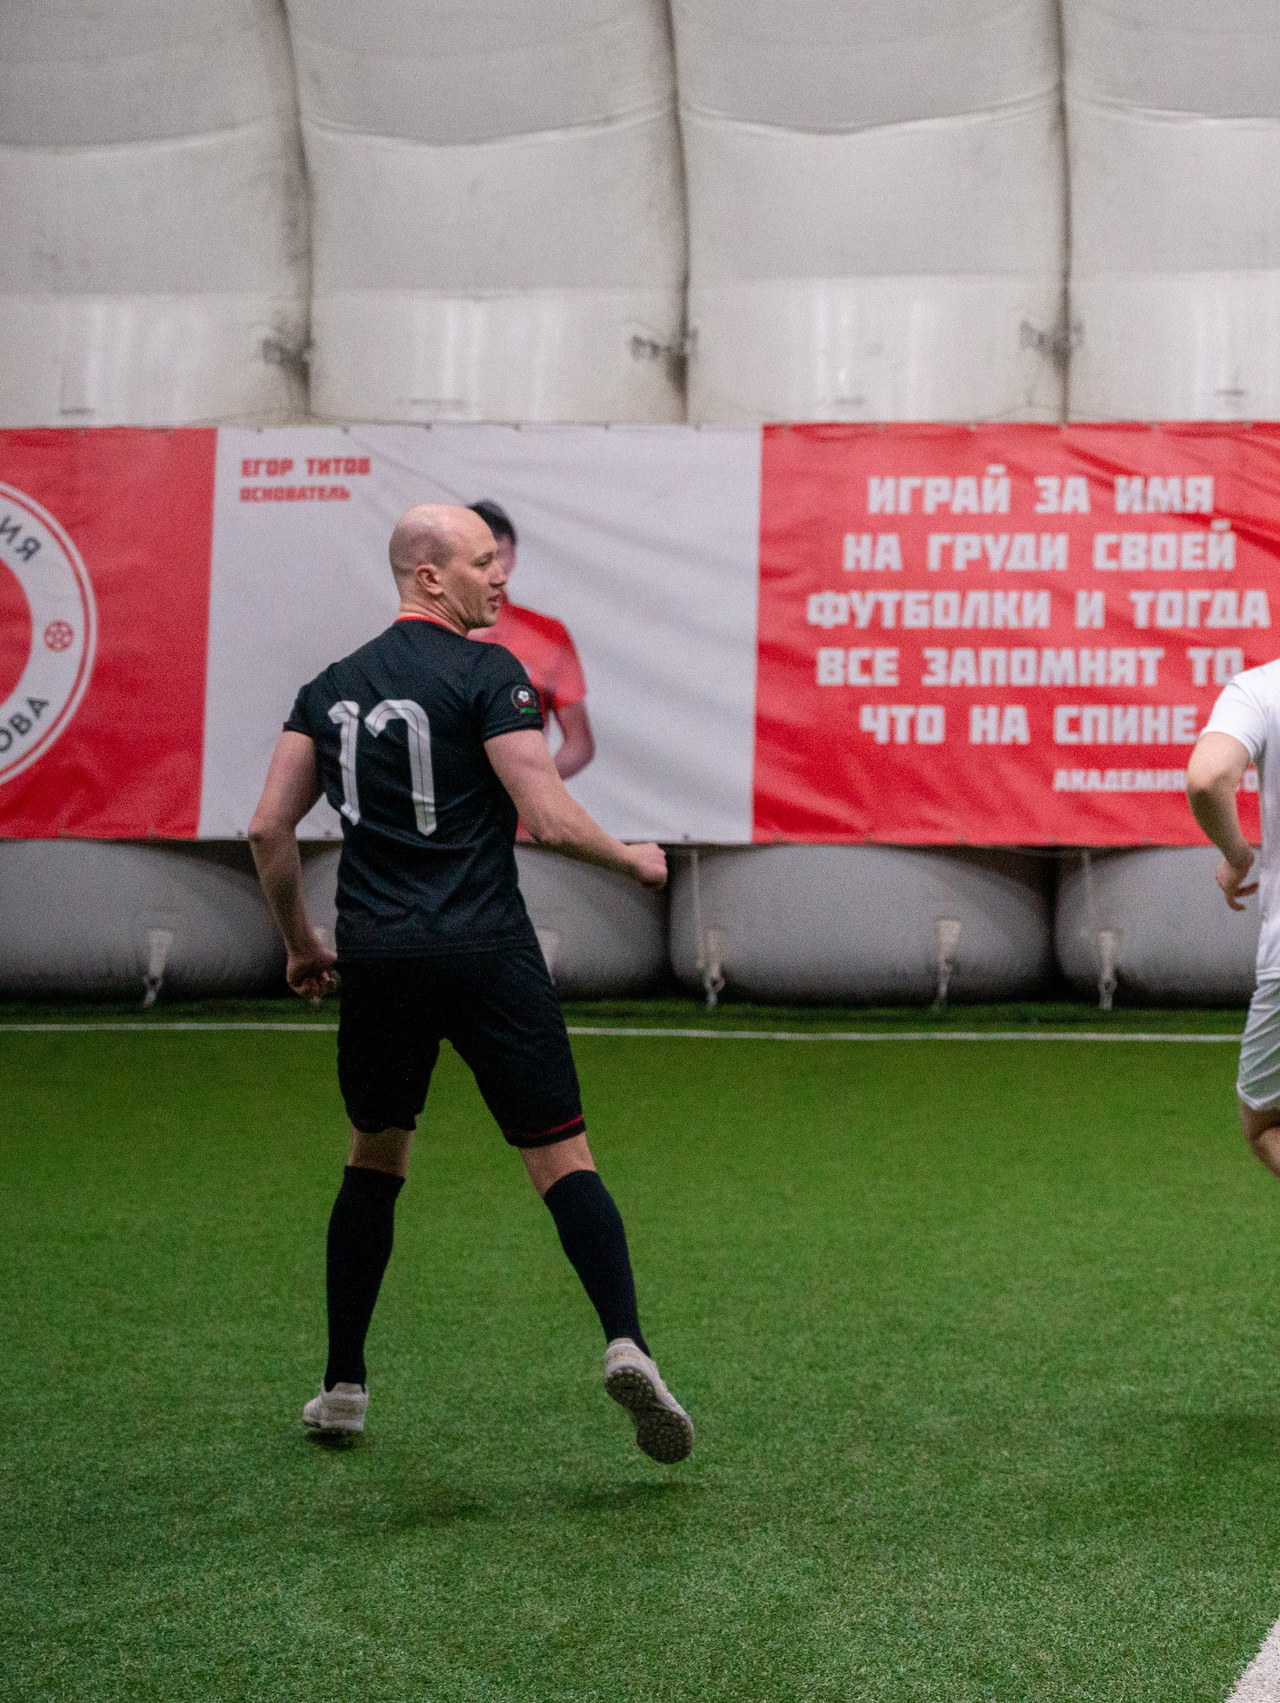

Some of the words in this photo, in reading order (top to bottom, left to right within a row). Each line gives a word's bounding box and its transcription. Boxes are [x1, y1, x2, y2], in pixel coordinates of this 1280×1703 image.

[241, 457, 294, 477] ЕГОР
[306, 456, 371, 476] ТИТОВ
[239, 485, 350, 501] ОСНОВАТЕЛЬ
[868, 465, 1010, 514] ИГРАЙ
[1035, 475, 1090, 514] ЗА
[1116, 475, 1214, 514] ИМЯ
[844, 534, 901, 571] НА
[927, 533, 1068, 571] ГРУДИ
[1094, 520, 1237, 570] СВОЕЙ
[807, 590, 1050, 629] ФУТБОЛКИ
[1077, 590, 1105, 628] И
[1131, 590, 1271, 628] ТОГДА
[817, 648, 899, 686] ВСЕ
[922, 648, 1165, 686] ЗАПОМНЯТ
[861, 706, 945, 744] ЧТО
[970, 706, 1030, 744] НА
[1054, 706, 1198, 744] СПИНЕ
[328, 699, 437, 836] 17
[1054, 769, 1187, 791] АКАДЕМИЯ
